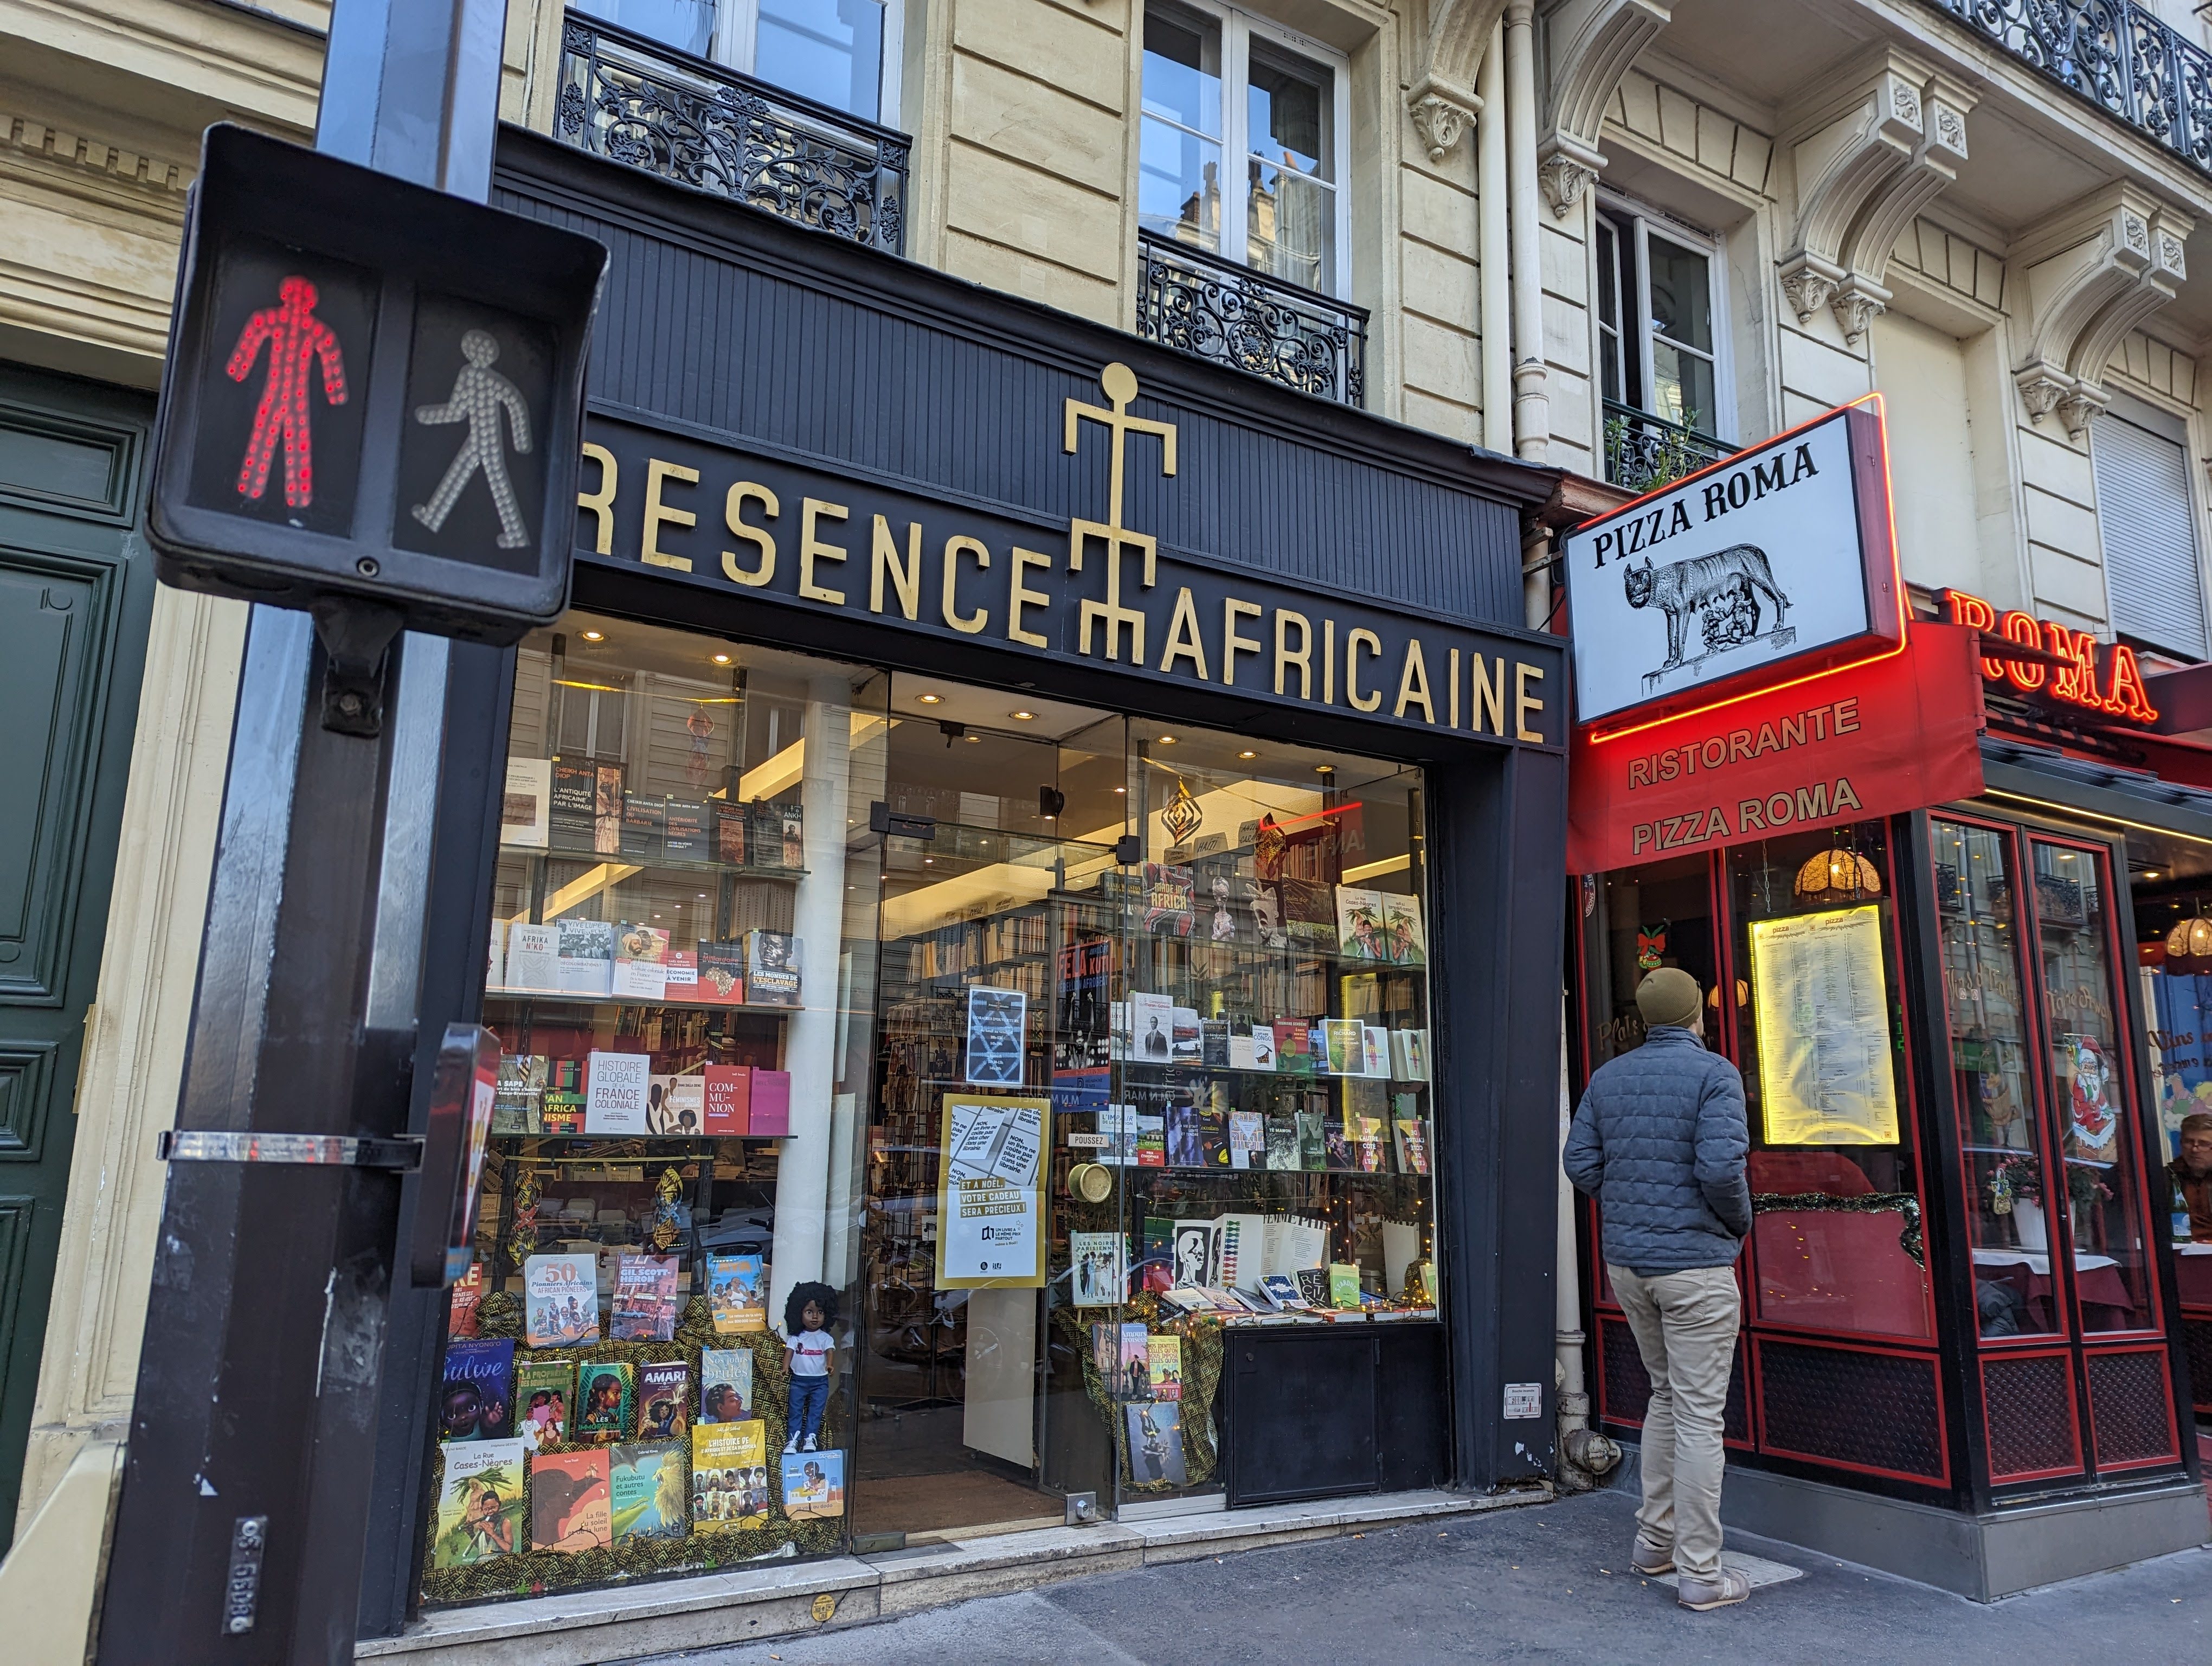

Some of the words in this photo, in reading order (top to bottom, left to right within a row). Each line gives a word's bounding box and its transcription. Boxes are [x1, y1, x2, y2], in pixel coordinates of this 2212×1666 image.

[1593, 499, 1693, 569] PIZZA
[1701, 442, 1819, 522] ROMA
[1945, 590, 2158, 724] ROMA
[1159, 587, 1544, 743] AFRICAINE
[1629, 697, 1861, 790] RISTORANTE
[554, 787, 591, 797] L'ANTIQUITÉ
[553, 794, 586, 803] AFRICAINE
[568, 802, 593, 810] L'IMAGE
[627, 806, 662, 815] CIVILISATION
[1632, 808, 1730, 855] PIZZA
[1739, 778, 1862, 833] ROMA
[1154, 882, 1174, 894] MADE
[1175, 885, 1182, 894] IN
[1151, 893, 1187, 910] AFRICA
[1825, 917, 1844, 926] pizza
[522, 935, 549, 944] AFRIKA
[526, 943, 543, 951] N'KO
[1058, 950, 1086, 981] FELA
[1089, 954, 1109, 975] KUTI
[753, 976, 798, 987] L'ESCLAVAGE
[1083, 976, 1108, 989] AFROBEAT
[598, 1060, 642, 1073] HISTOIRE
[597, 1071, 641, 1084] GLOBALE
[709, 1083, 738, 1092] COM-
[596, 1088, 640, 1100] FRANCE
[709, 1093, 730, 1102] MU-
[595, 1099, 639, 1110] COLONIALE
[709, 1103, 735, 1113] NION
[1010, 1135, 1024, 1145] NON,
[1075, 1136, 1103, 1145] POUSSEZ
[1006, 1145, 1022, 1154] coûte
[1015, 1143, 1028, 1151] livre
[1001, 1156, 1015, 1164] dans
[1003, 1150, 1015, 1158] plus
[1016, 1155, 1030, 1163] cher
[999, 1161, 1022, 1174] librairie.
[961, 1181, 971, 1190] ET
[973, 1179, 979, 1189] À
[982, 1178, 1004, 1189] NOËL,
[961, 1193, 986, 1203] VOTRE
[989, 1191, 1020, 1201] CADEAU
[962, 1207, 982, 1216] SERA
[985, 1204, 1021, 1215] PRÉCIEUX
[545, 1263, 576, 1283] 50
[1334, 1278, 1359, 1294] STARDUST
[708, 1356, 723, 1364] Nos
[725, 1356, 749, 1366] jours
[522, 1371, 531, 1380] LA
[644, 1370, 686, 1383] AMARI
[707, 1366, 748, 1379] brûlés
[577, 1422, 625, 1431] IMMORTELLES
[709, 1438, 740, 1447] L'HISTOIRE
[740, 1436, 749, 1445] DE
[454, 1458, 513, 1470] Cases-Nègres
[616, 1474, 645, 1483] Fukubutu
[595, 1511, 607, 1519] fille
[590, 1518, 607, 1526] soleil
